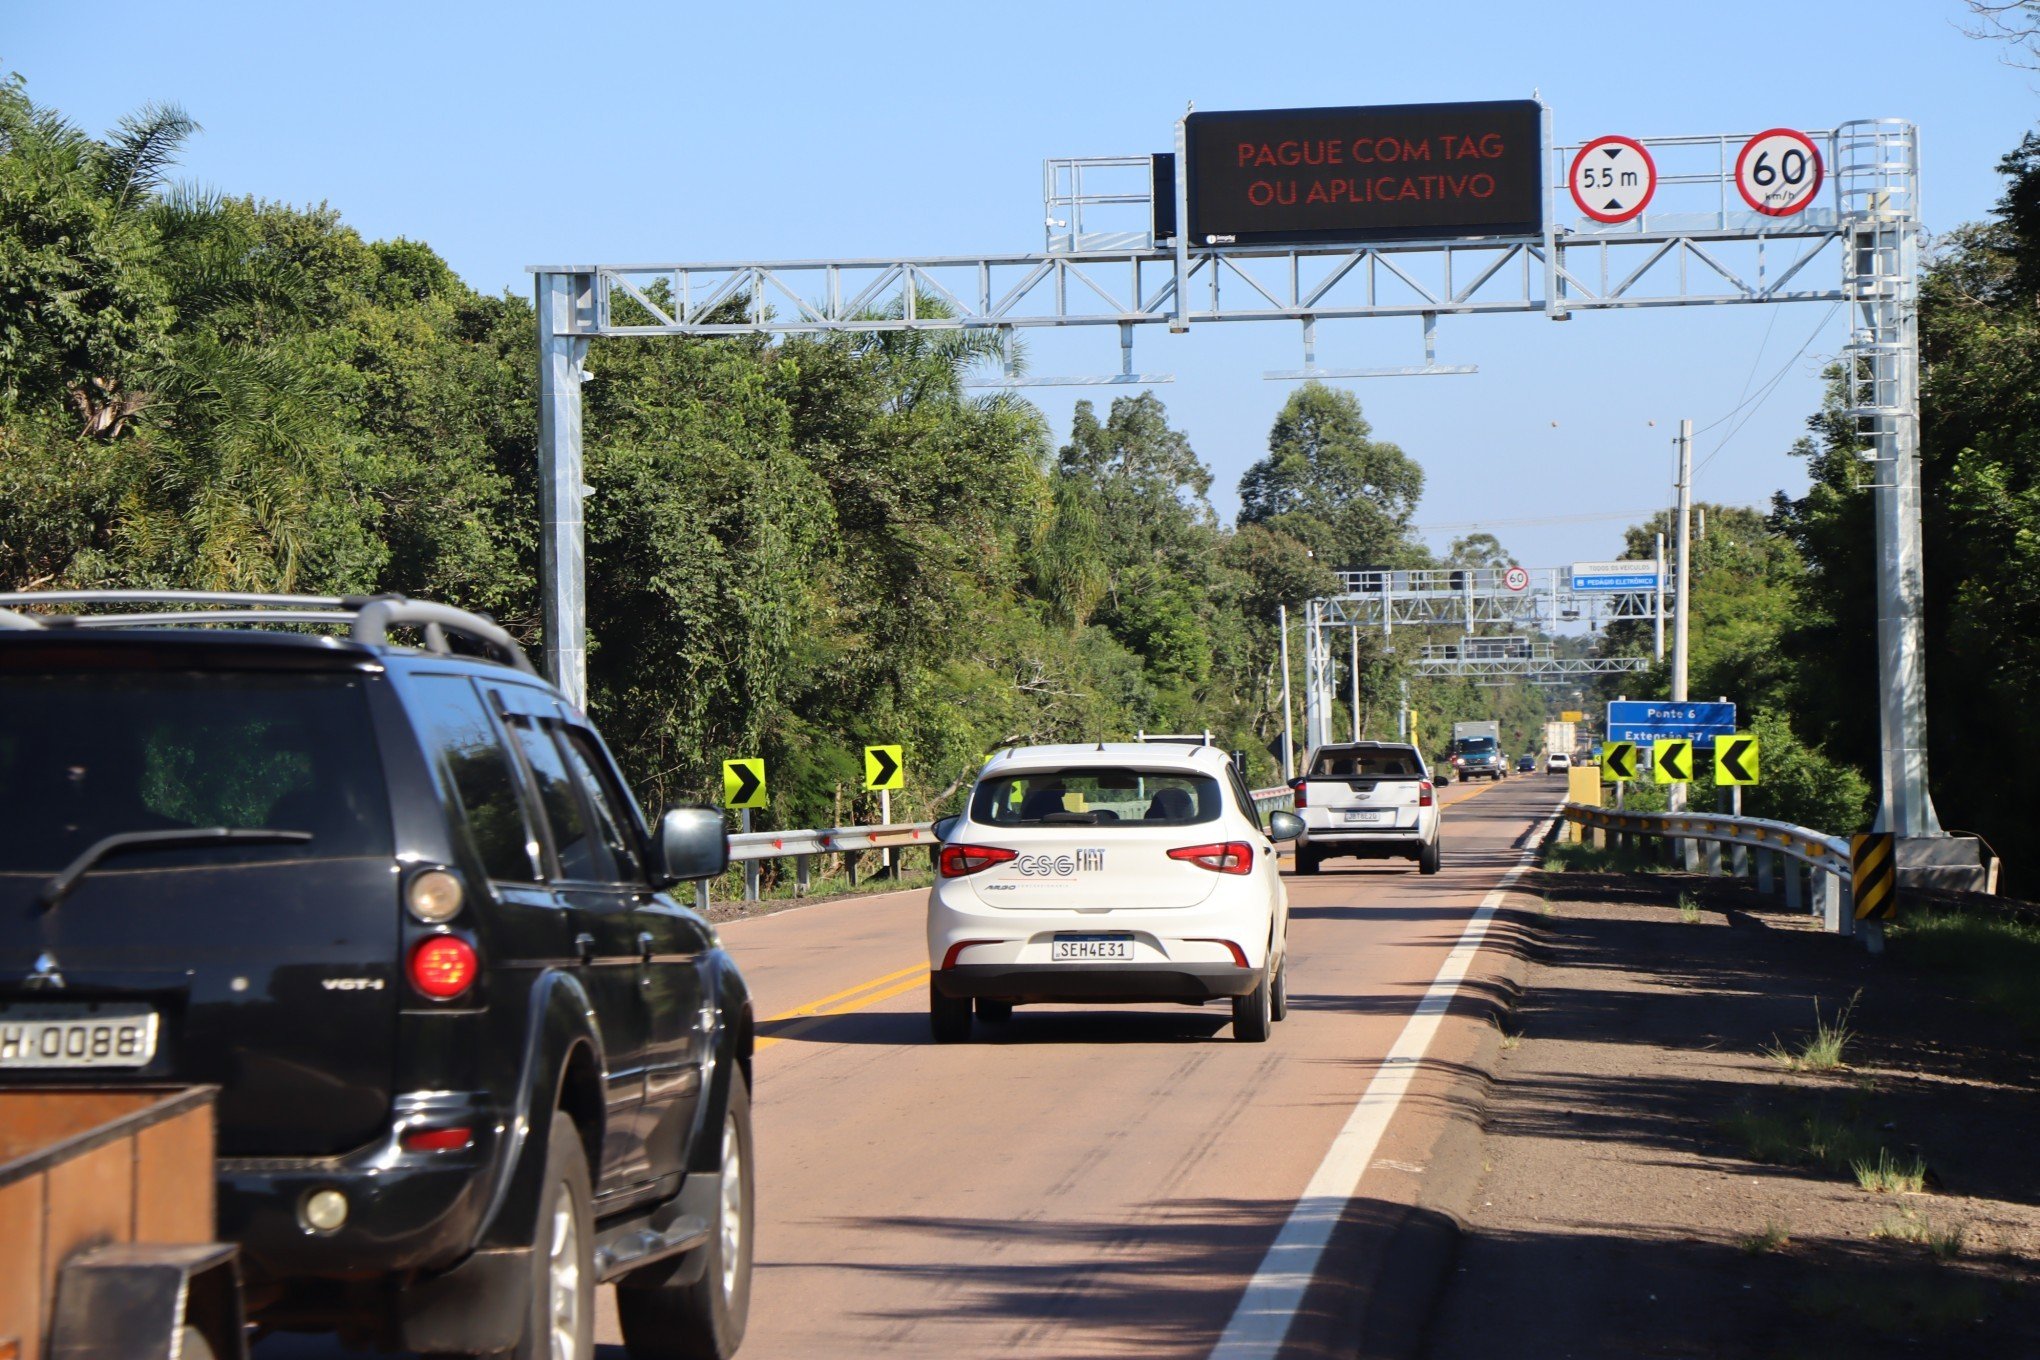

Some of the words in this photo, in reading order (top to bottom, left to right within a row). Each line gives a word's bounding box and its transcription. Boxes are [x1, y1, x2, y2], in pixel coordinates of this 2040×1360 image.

[1237, 139, 1343, 167] PAGUE
[1351, 136, 1432, 163] COM
[1438, 132, 1505, 159] TAG
[1753, 148, 1806, 187] 60
[1621, 172, 1638, 187] m
[1247, 178, 1297, 206] OU
[1304, 172, 1496, 204] APLICATIVO
[1765, 190, 1796, 201] km/h
[1509, 573, 1524, 583] 60
[1647, 708, 1684, 718] Ponte
[1688, 709, 1697, 719] 6
[1687, 731, 1703, 742] 57
[1017, 855, 1075, 877] CSG
[1076, 848, 1106, 872] FIAT
[1061, 943, 1126, 957] SEH4E31
